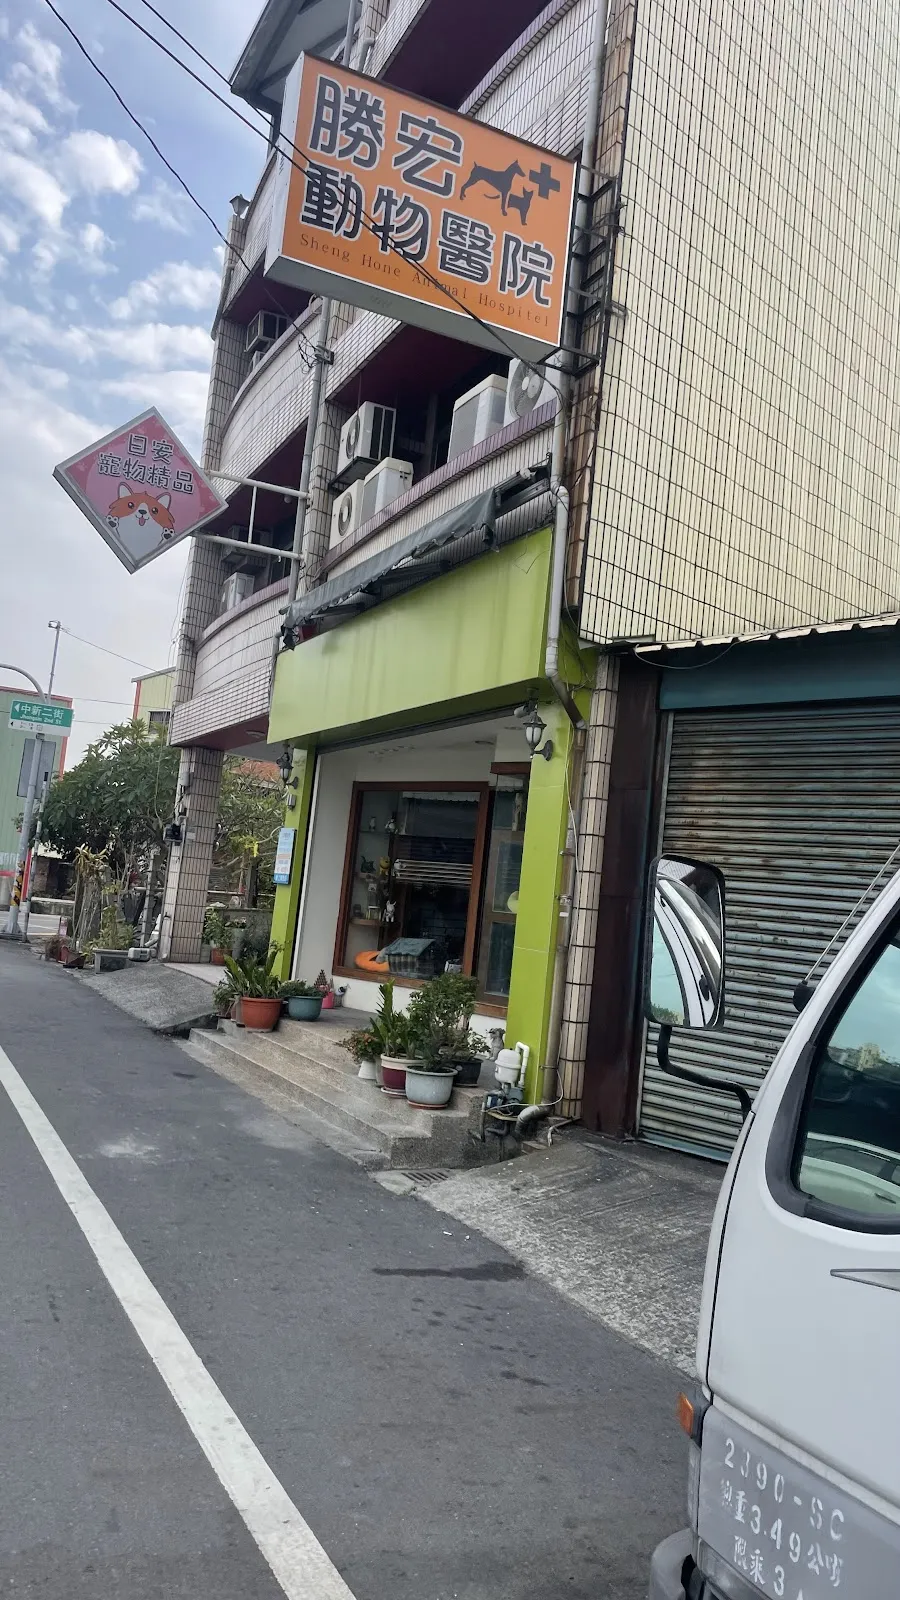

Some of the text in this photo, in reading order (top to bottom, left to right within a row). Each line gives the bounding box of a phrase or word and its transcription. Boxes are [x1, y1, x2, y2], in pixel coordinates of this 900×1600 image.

[309, 74, 464, 196] 勝宏
[300, 161, 554, 306] 動物醫院
[300, 233, 350, 263] Sheng
[361, 254, 401, 277] Hone
[412, 271, 467, 299] Animal
[98, 452, 194, 495] 寵物精品
[128, 433, 174, 465] 日安
[21, 703, 64, 719] 中新二街
